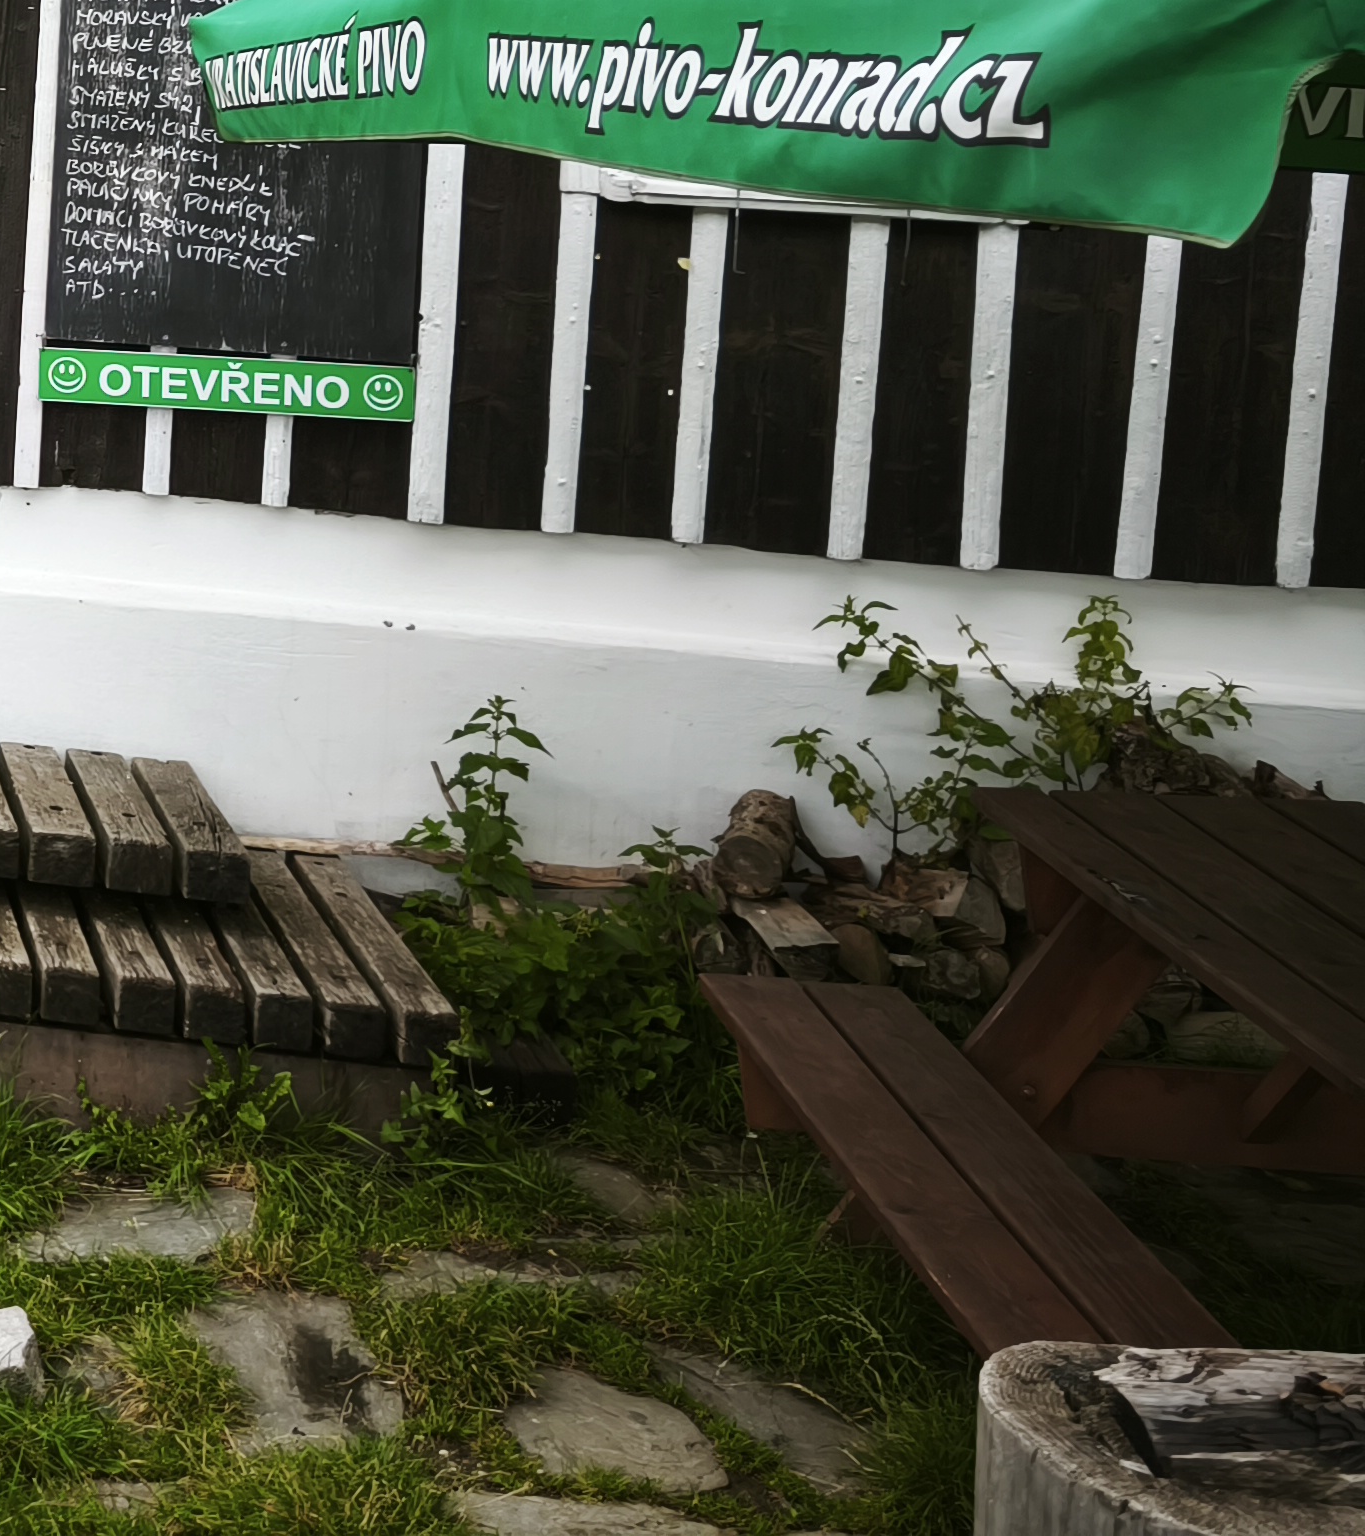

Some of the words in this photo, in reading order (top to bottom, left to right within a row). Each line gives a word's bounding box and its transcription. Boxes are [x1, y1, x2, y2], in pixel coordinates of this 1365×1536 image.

[204, 12, 359, 112] VRATISLAVICKÉ
[356, 17, 427, 95] PIVO
[485, 17, 1049, 144] www.pivo-konrad.cz
[98, 361, 350, 410] OTEVŘENO
